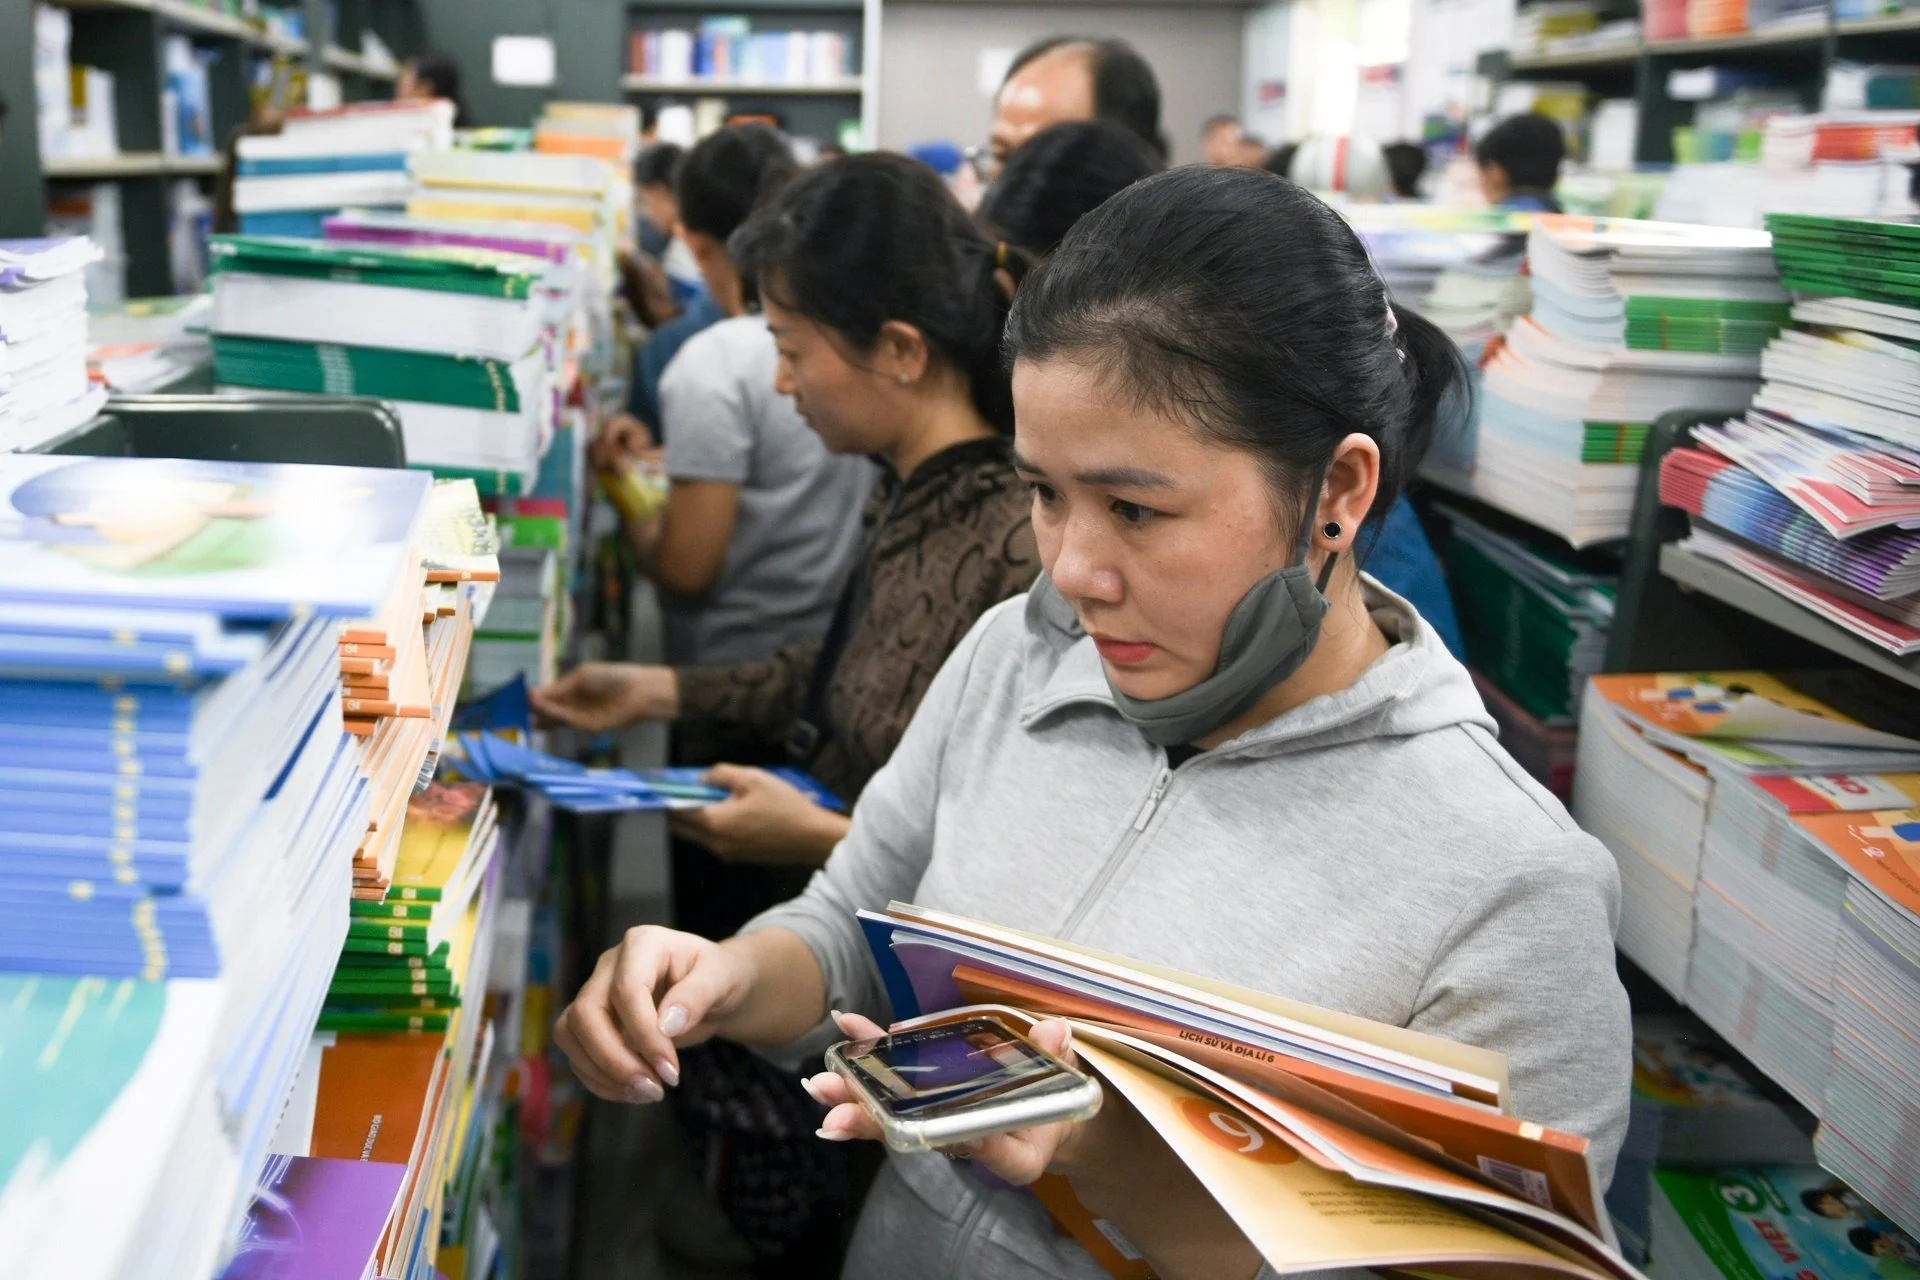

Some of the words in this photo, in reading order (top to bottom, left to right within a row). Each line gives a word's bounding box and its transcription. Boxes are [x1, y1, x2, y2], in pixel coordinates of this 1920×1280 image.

[1179, 1030, 1203, 1044] LỊCH
[1220, 1040, 1233, 1052] VÀ
[1235, 1046, 1254, 1057] ĐỊA
[1255, 1051, 1267, 1061] LÍ
[1267, 1055, 1275, 1063] 6
[1720, 1184, 1759, 1206] 3
